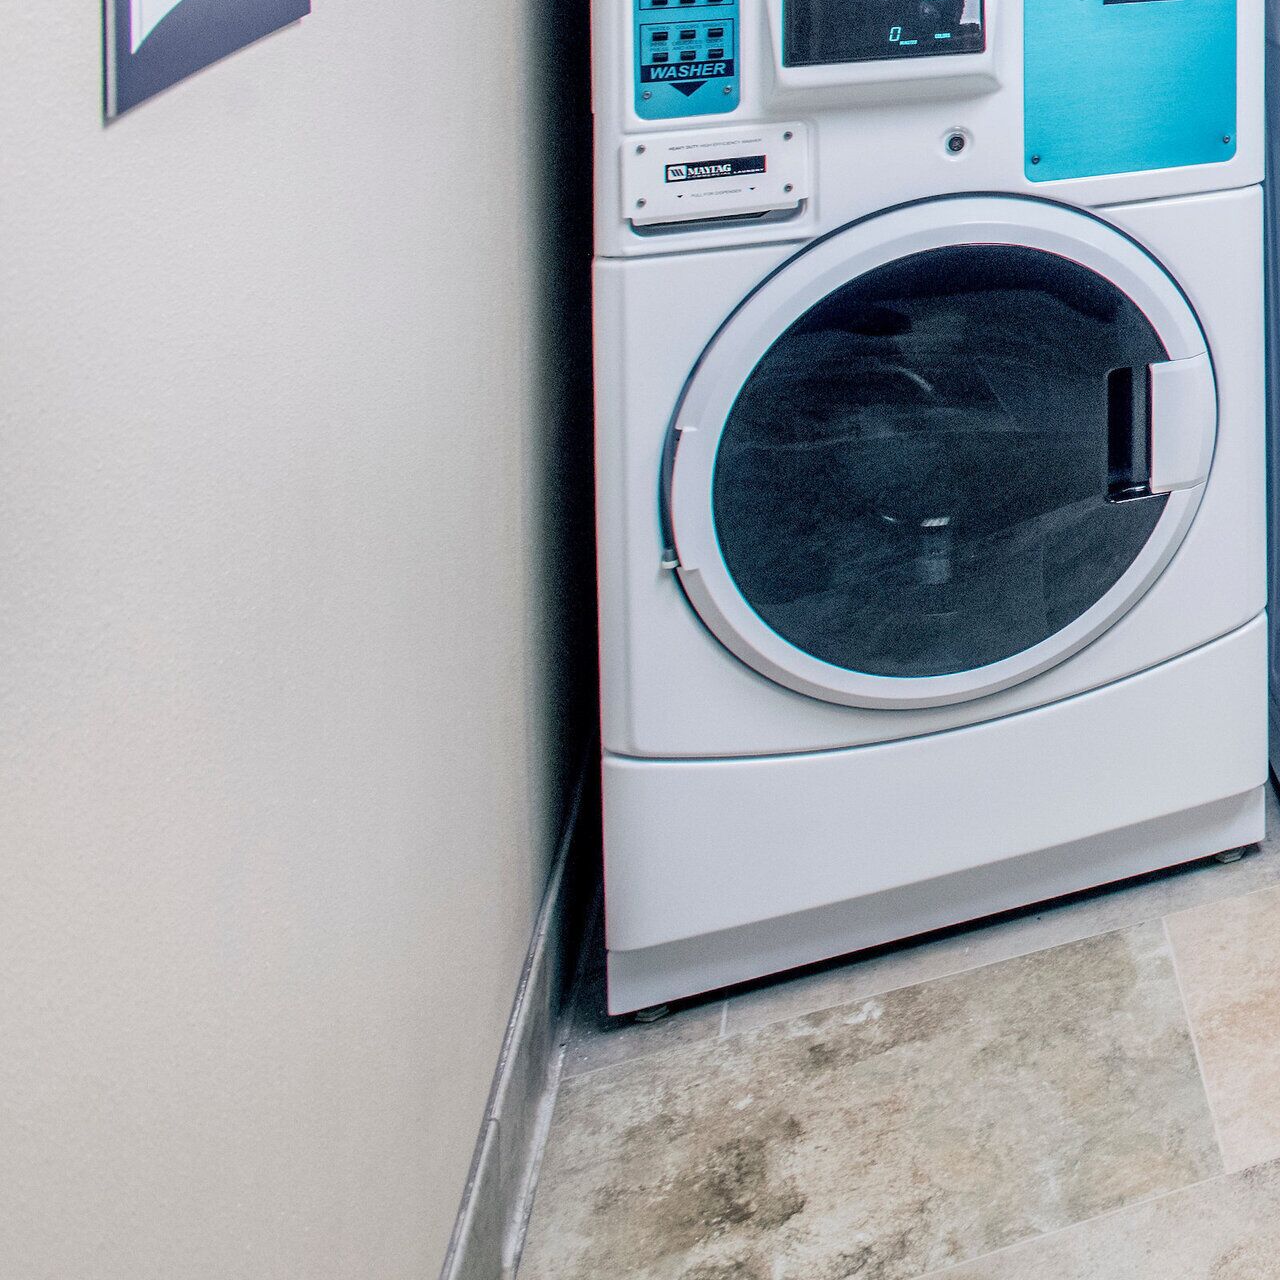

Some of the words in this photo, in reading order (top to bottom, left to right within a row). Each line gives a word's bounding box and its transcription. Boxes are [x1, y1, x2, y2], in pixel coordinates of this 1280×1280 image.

[889, 26, 901, 42] 0
[650, 62, 727, 80] WASHER
[687, 163, 732, 177] MAYTAG
